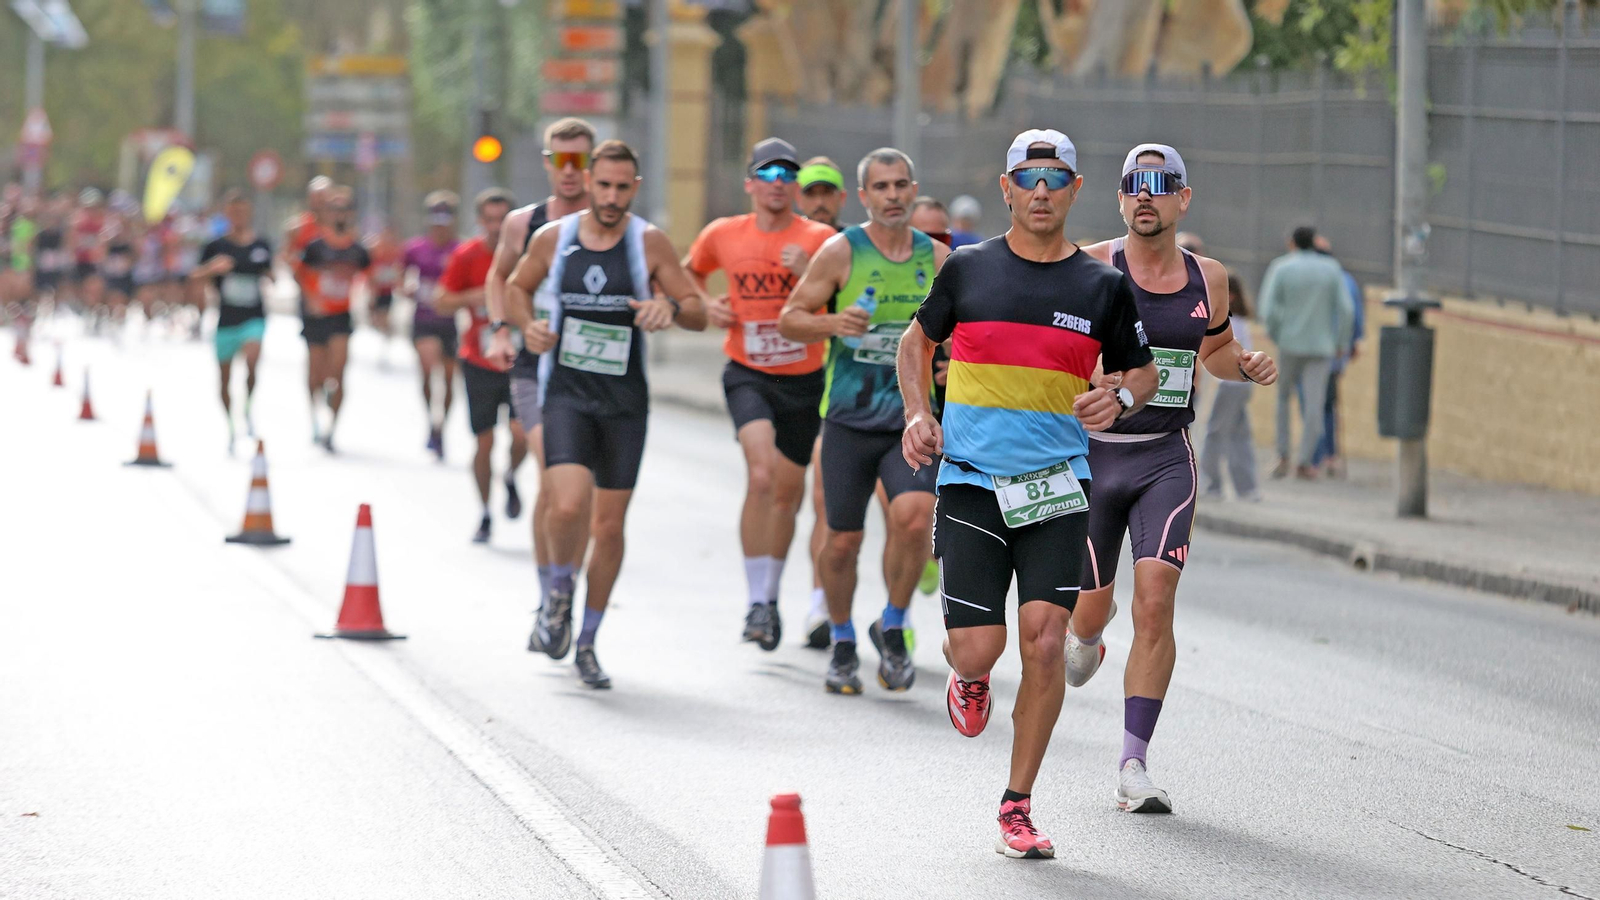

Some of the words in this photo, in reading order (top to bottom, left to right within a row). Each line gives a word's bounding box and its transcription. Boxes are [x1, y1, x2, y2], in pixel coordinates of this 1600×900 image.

[584, 339, 607, 355] 77
[1025, 480, 1055, 500] 82
[1036, 498, 1081, 517] Mizuno
